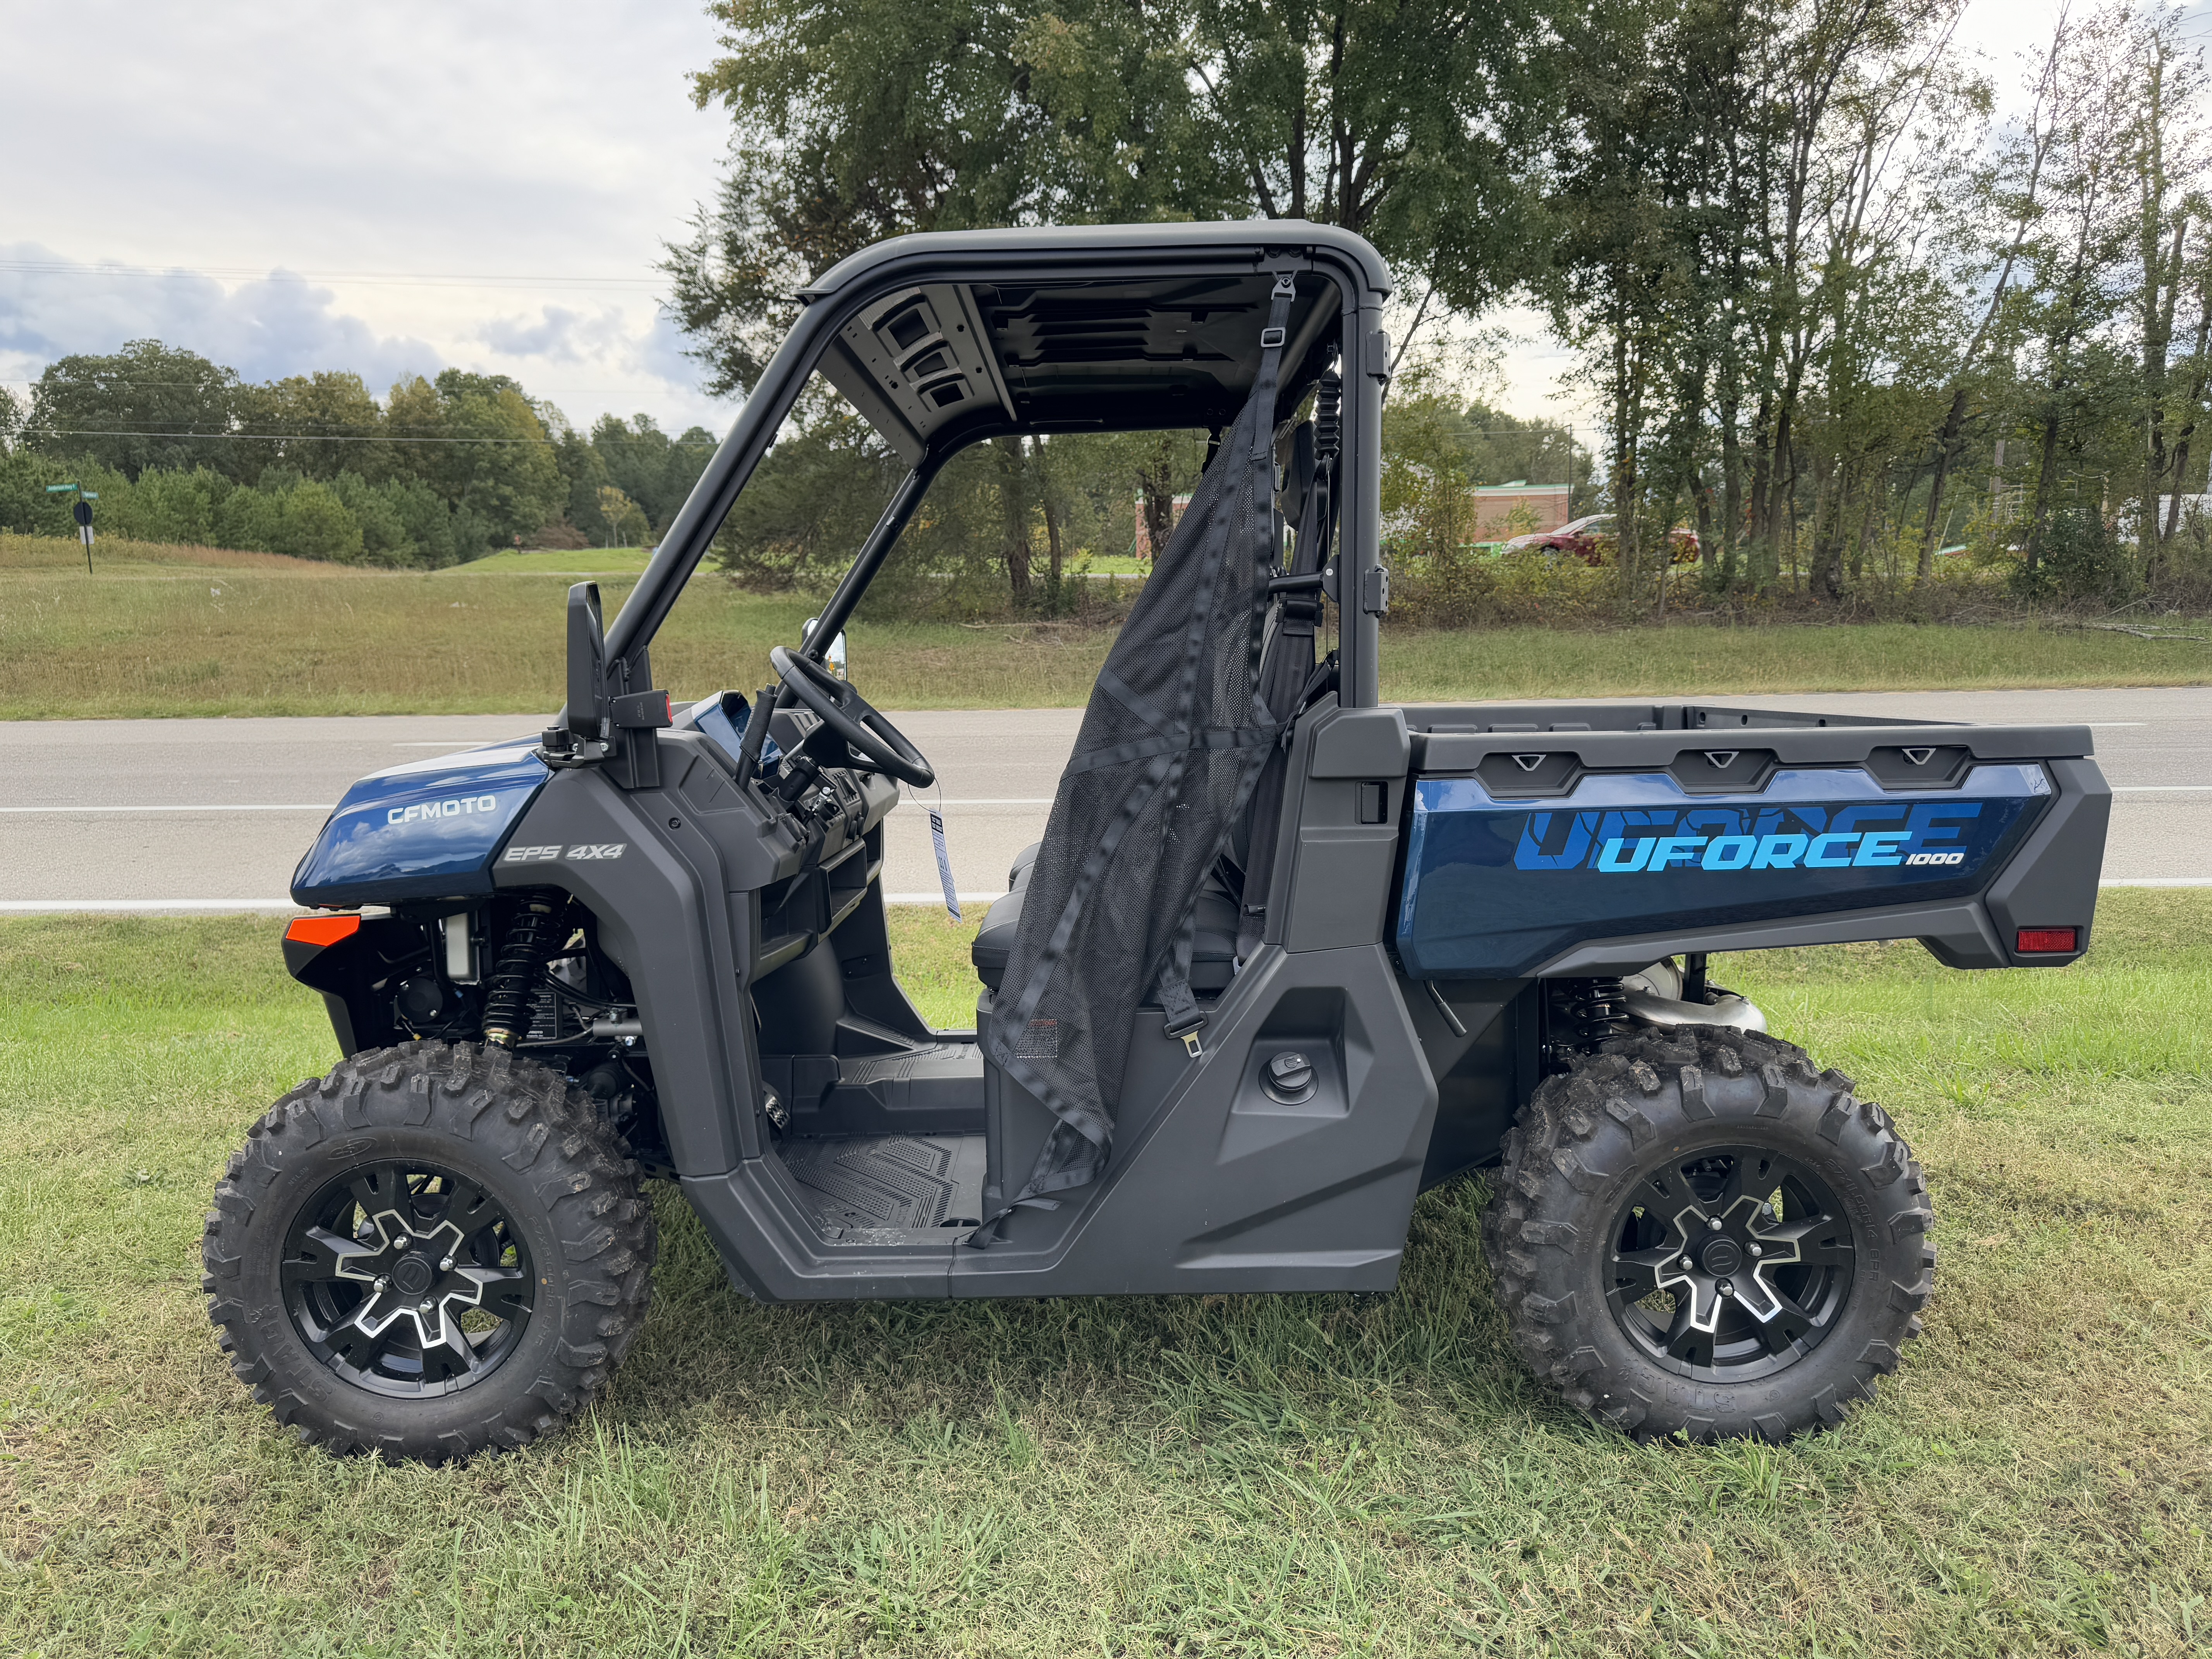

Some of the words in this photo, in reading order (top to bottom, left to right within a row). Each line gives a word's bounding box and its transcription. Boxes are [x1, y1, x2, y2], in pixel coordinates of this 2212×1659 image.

[388, 795, 496, 824] CFMOTO
[505, 846, 558, 861] EPS
[567, 844, 623, 859] 4X4
[1597, 831, 1912, 872] UFORCE
[1905, 852, 1964, 866] 1000
[288, 1165, 309, 1187] NYLON
[1868, 1249, 1881, 1282] 8PR
[259, 1319, 333, 1402] STAG
